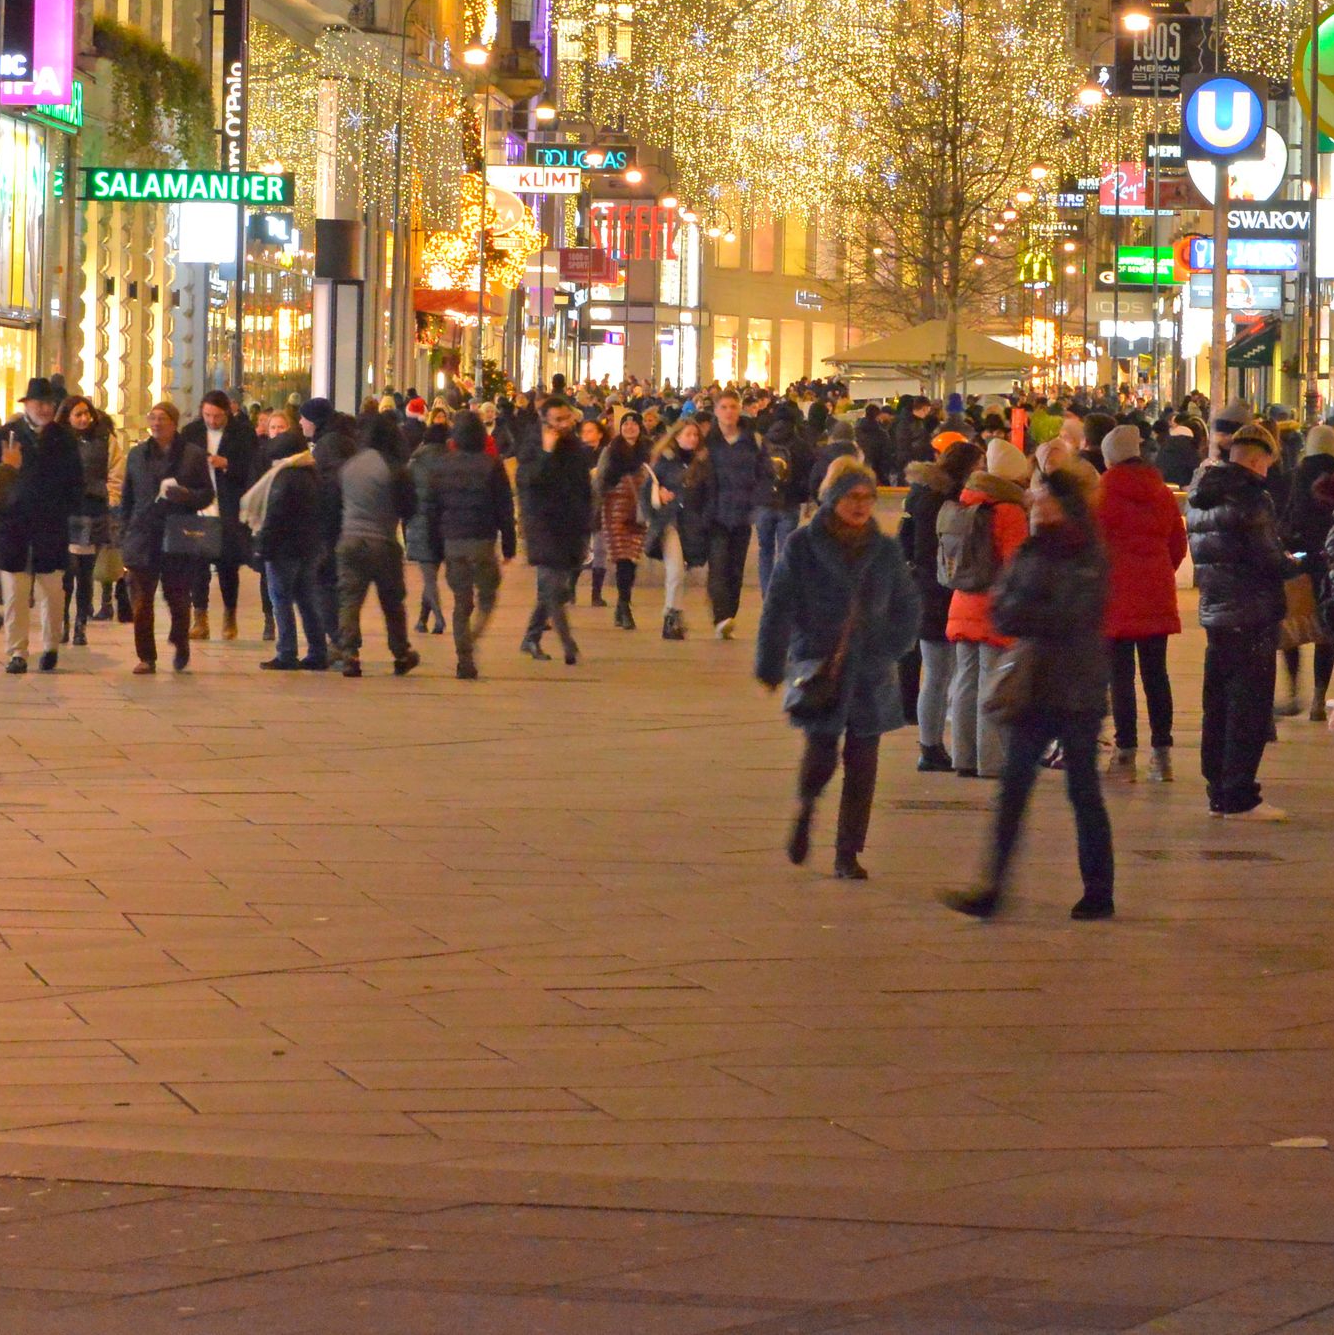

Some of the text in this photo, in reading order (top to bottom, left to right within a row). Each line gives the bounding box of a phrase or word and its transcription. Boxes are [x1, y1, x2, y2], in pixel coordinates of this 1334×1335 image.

[1132, 23, 1181, 61] LOOS
[1132, 65, 1180, 73] AMERICAN
[1197, 91, 1251, 148] U
[535, 149, 628, 170] DOUGAS
[94, 171, 284, 202] SALAMANDER
[519, 173, 579, 187] KLIMT
[1227, 210, 1310, 230] SWAROV
